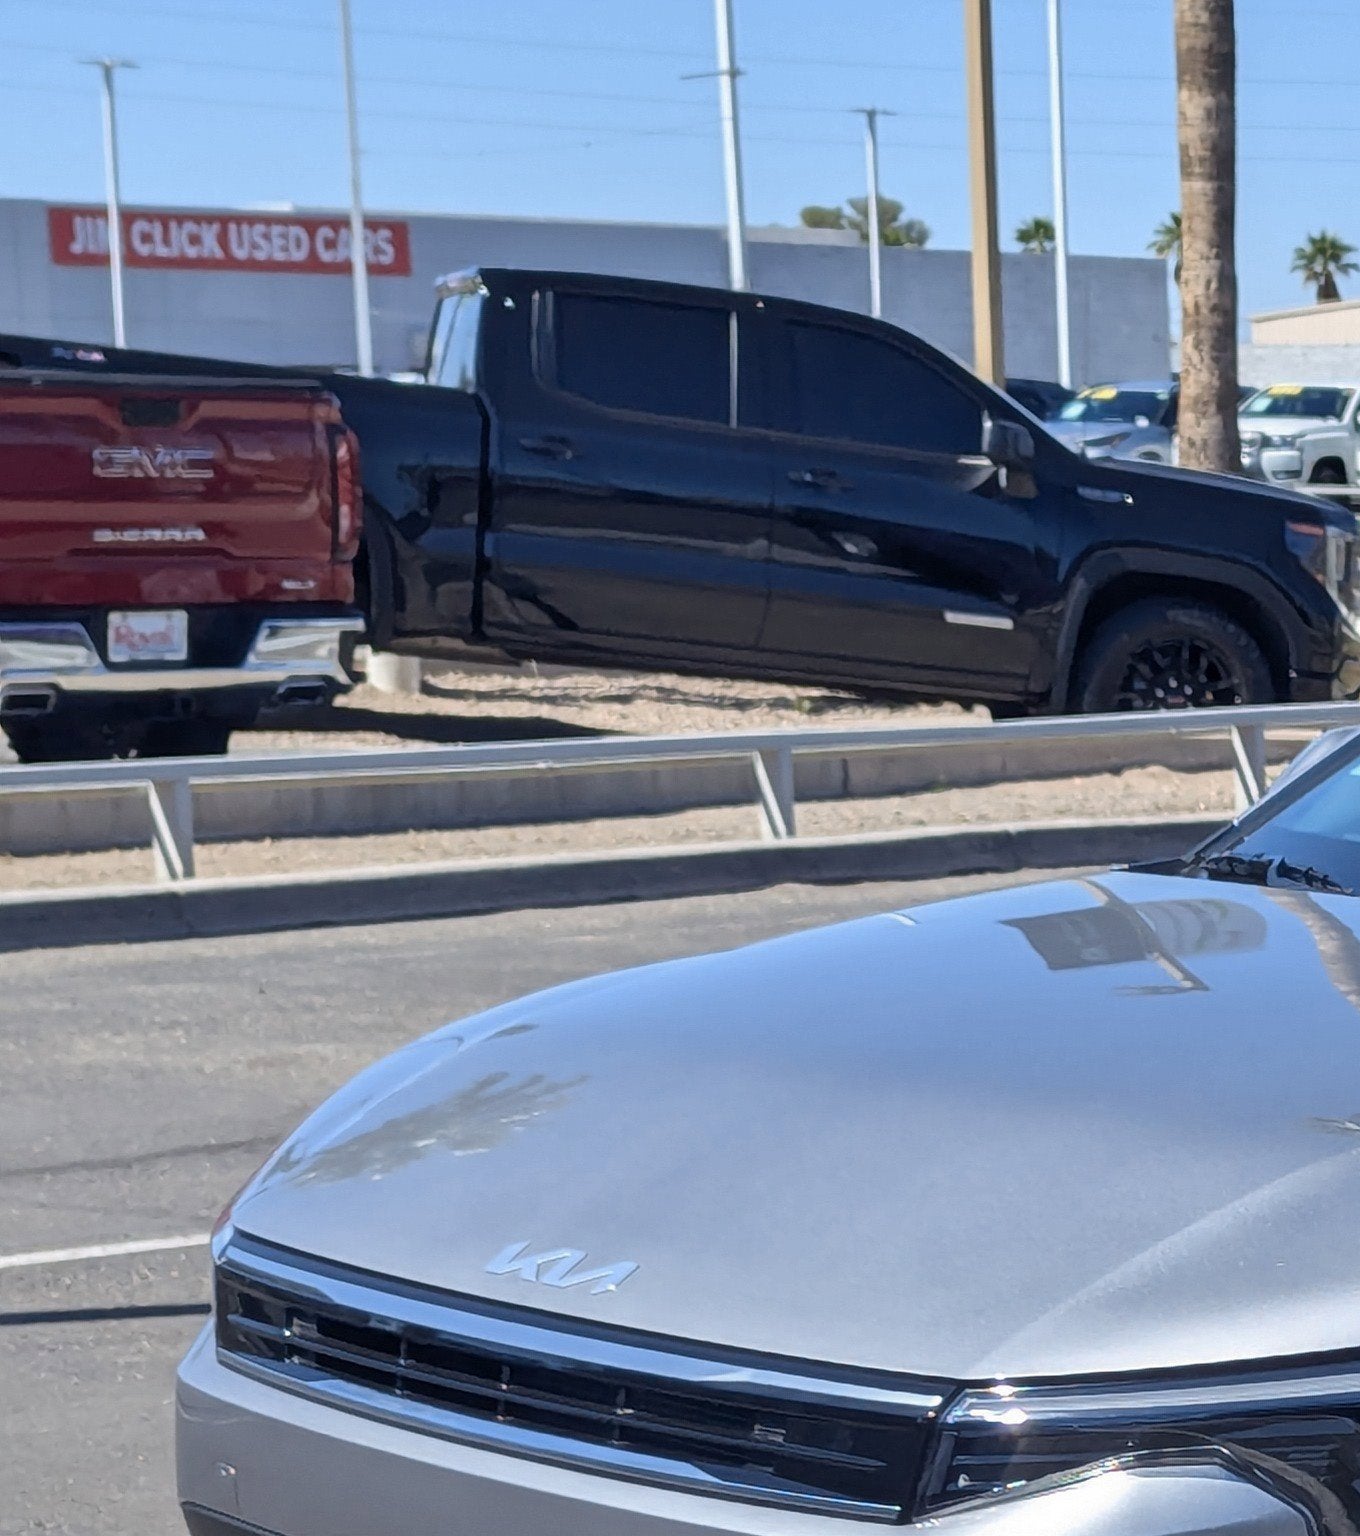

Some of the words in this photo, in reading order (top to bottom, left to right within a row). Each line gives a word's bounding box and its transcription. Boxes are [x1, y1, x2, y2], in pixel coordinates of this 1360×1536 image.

[131, 219, 226, 259] CLICK
[227, 221, 310, 262] USED
[93, 445, 214, 478] GMC
[484, 1239, 640, 1296] KIA
